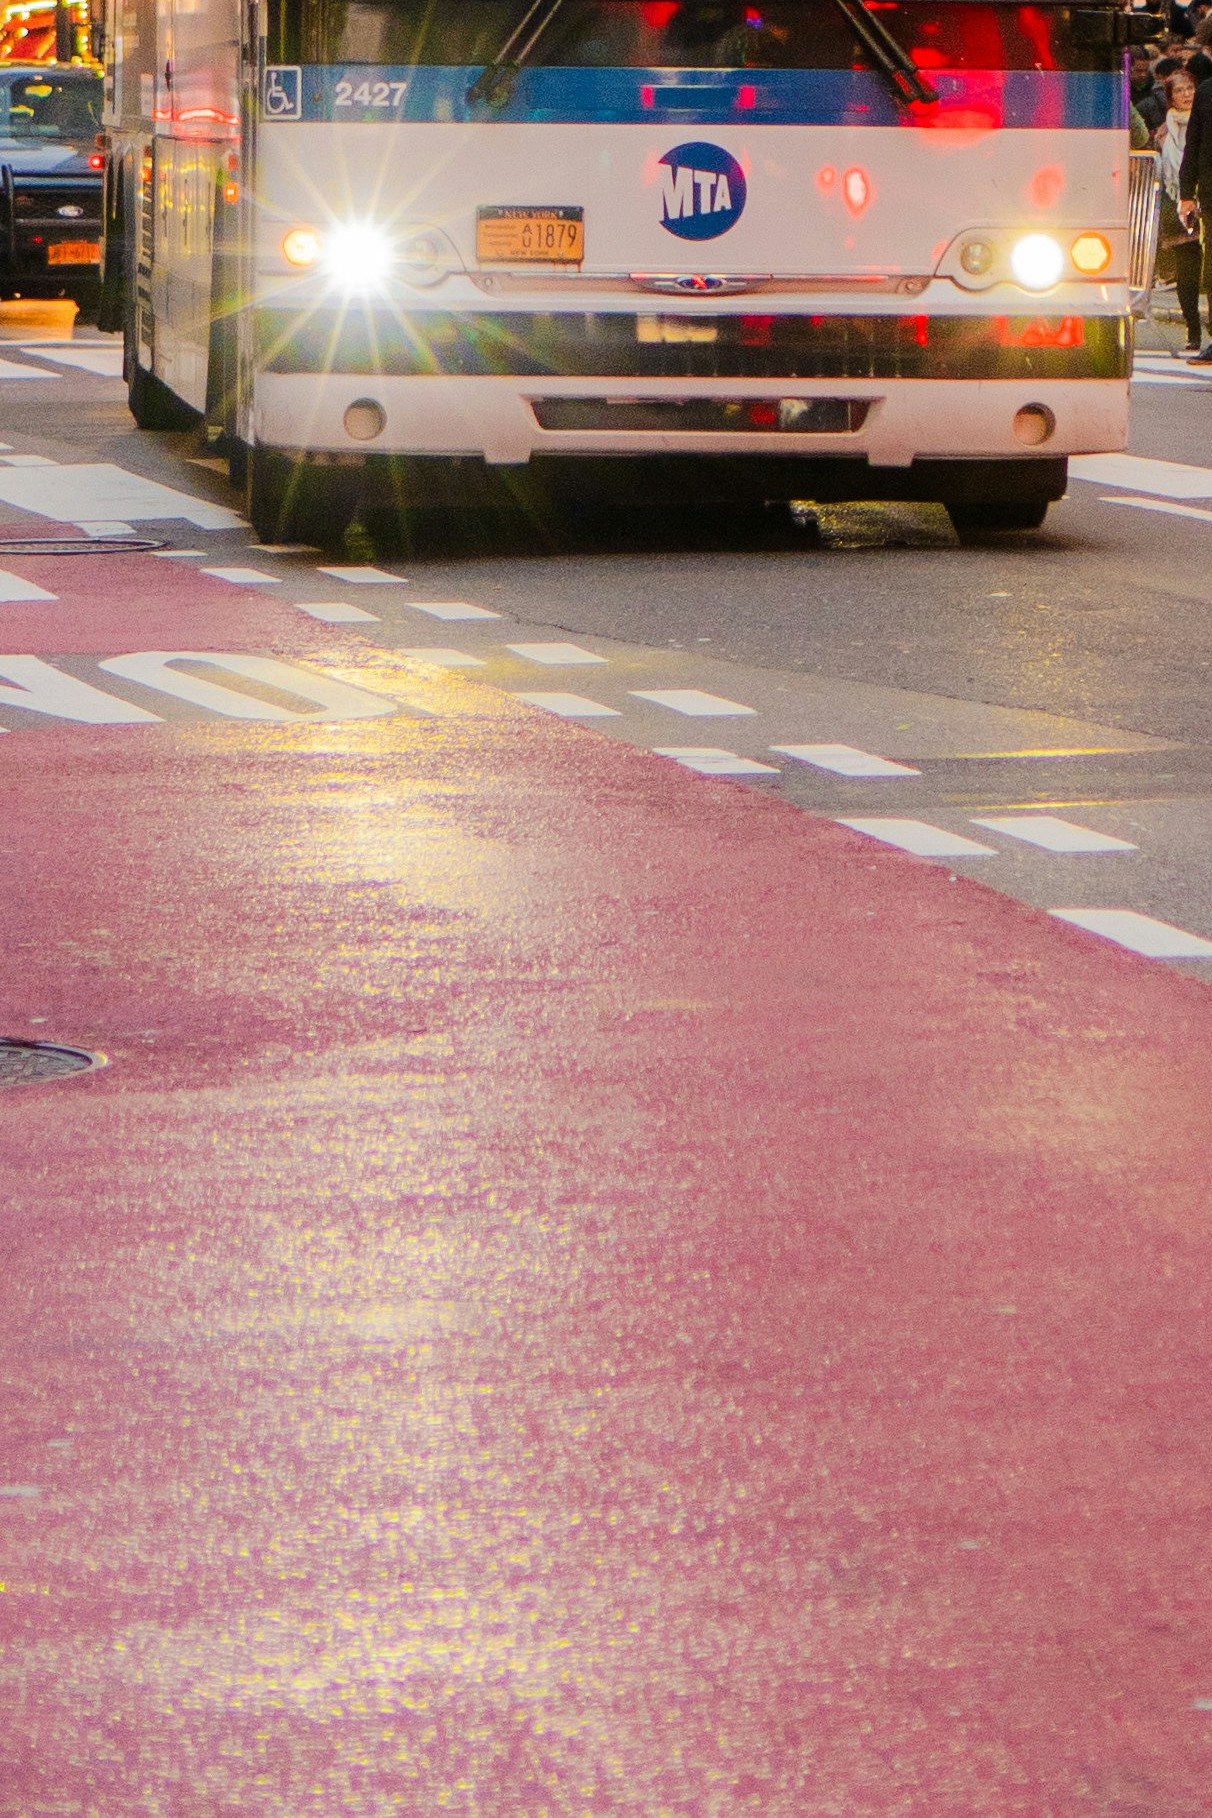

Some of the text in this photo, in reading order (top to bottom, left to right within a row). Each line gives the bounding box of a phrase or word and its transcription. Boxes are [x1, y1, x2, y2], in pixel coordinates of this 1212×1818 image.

[335, 81, 407, 108] 2427
[659, 162, 733, 222] MTA
[504, 209, 558, 220] NEW YORK
